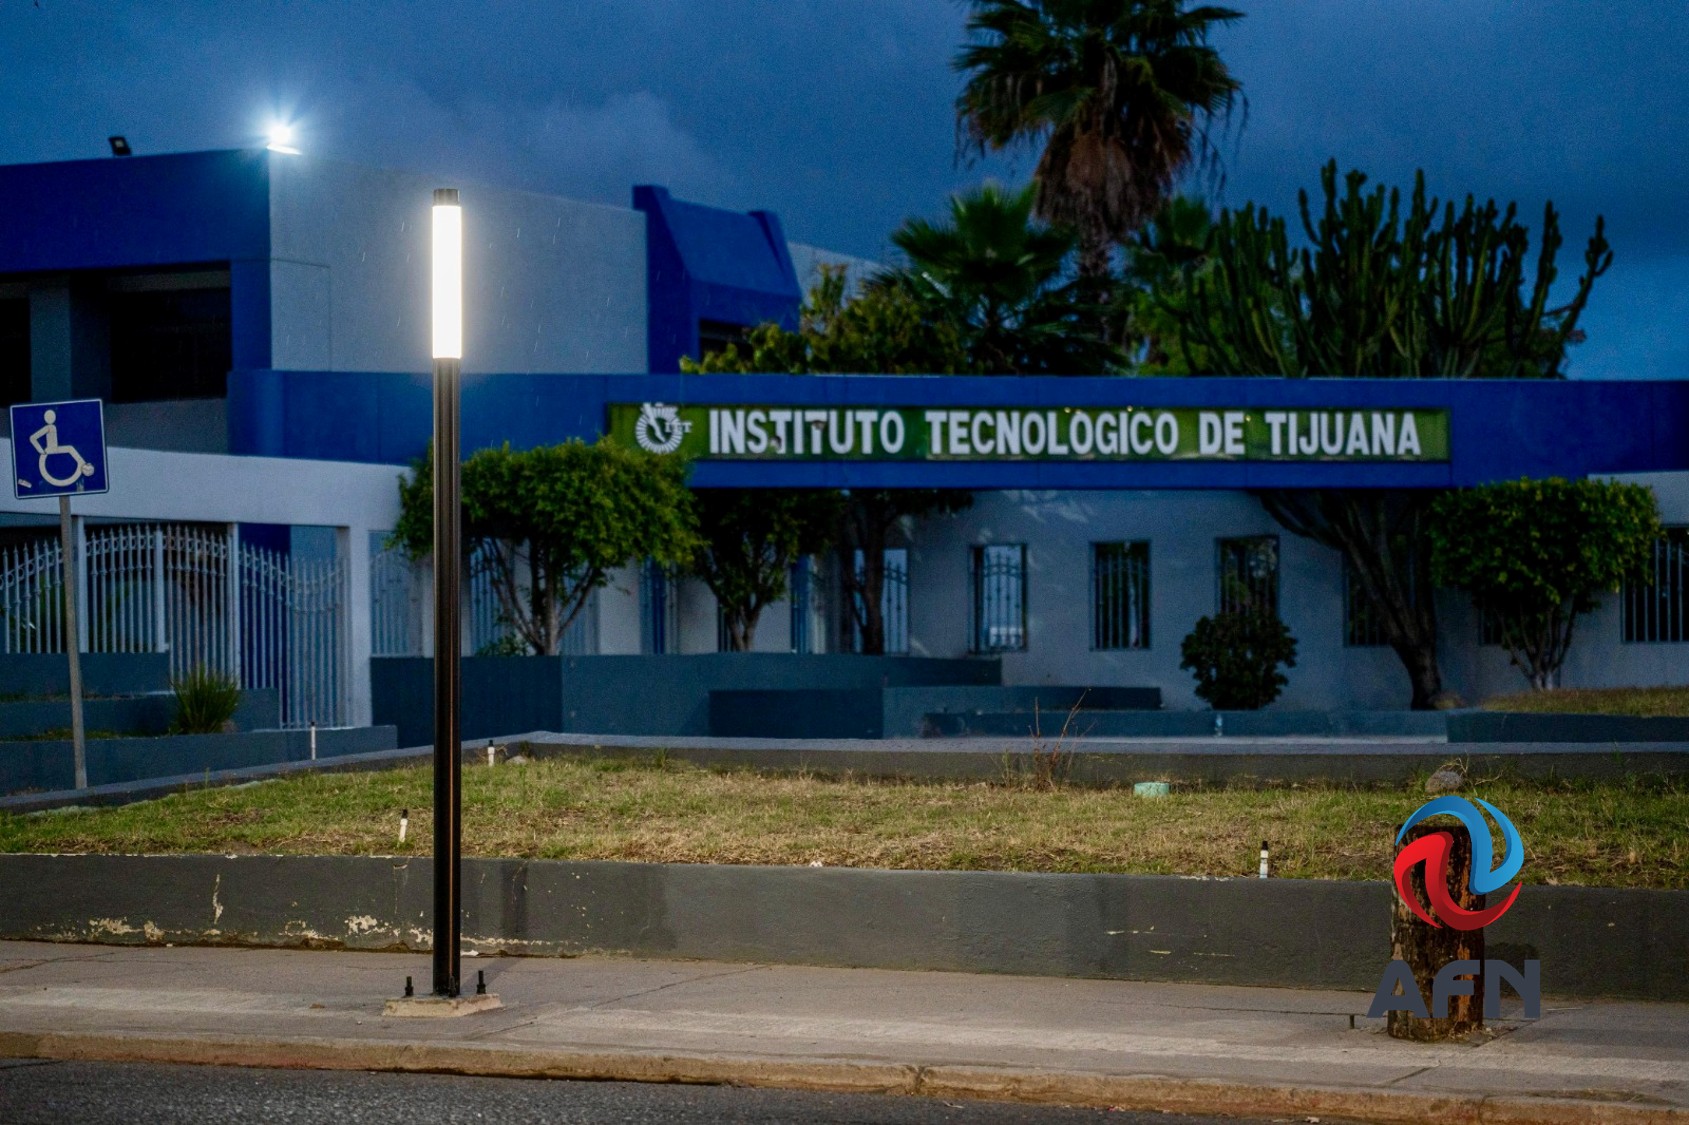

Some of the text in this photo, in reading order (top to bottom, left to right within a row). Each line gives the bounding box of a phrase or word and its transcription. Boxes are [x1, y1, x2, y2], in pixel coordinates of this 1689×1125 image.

[709, 409, 1421, 456] INSTITUTO TECNOLOGICO DE TIJUANA
